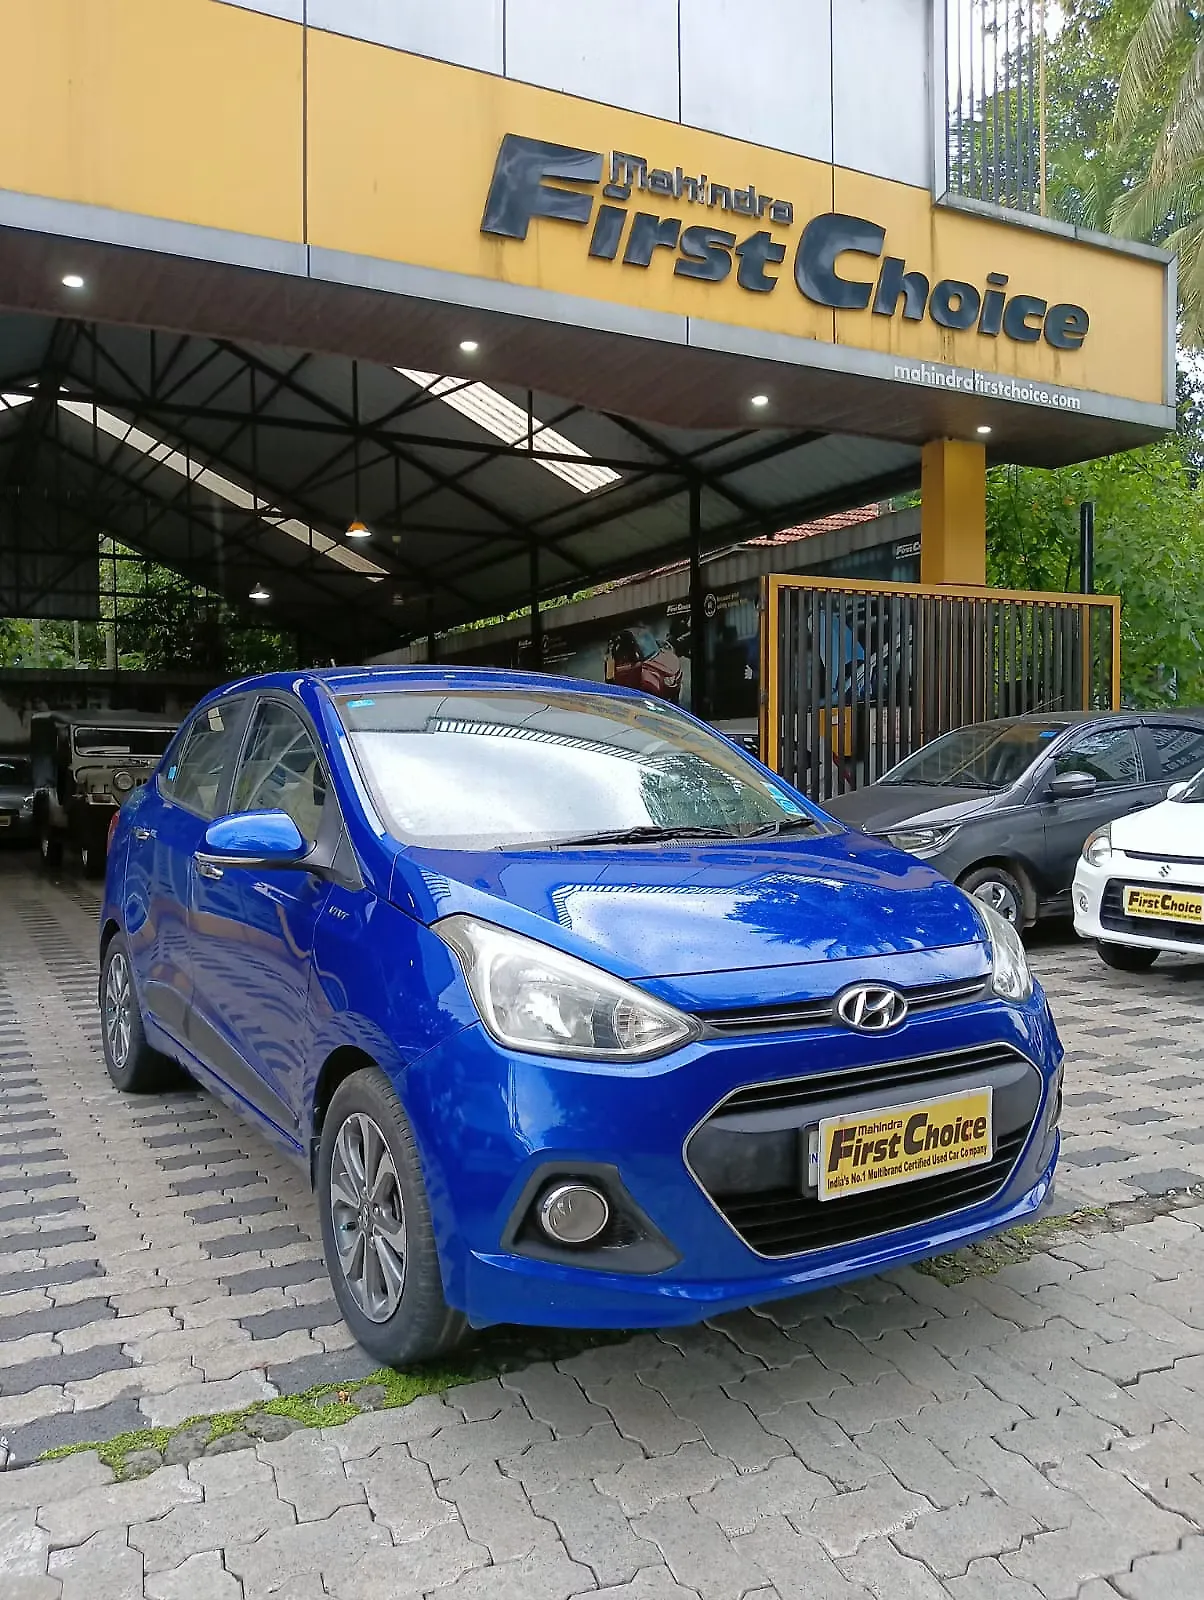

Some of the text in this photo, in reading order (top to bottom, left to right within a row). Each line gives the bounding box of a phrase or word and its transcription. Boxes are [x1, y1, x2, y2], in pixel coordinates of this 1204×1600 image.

[608, 149, 794, 226] Mahindra
[479, 132, 1090, 350] First Choice
[894, 363, 1081, 410] mahindrafirstchoice.com
[1128, 891, 1160, 909] First
[1161, 894, 1202, 914] Choice
[828, 1112, 987, 1173] First Choice
[858, 1119, 903, 1137] Mahindra
[827, 1143, 987, 1190] India's No.1 Multibrand Certified Used Car Company
